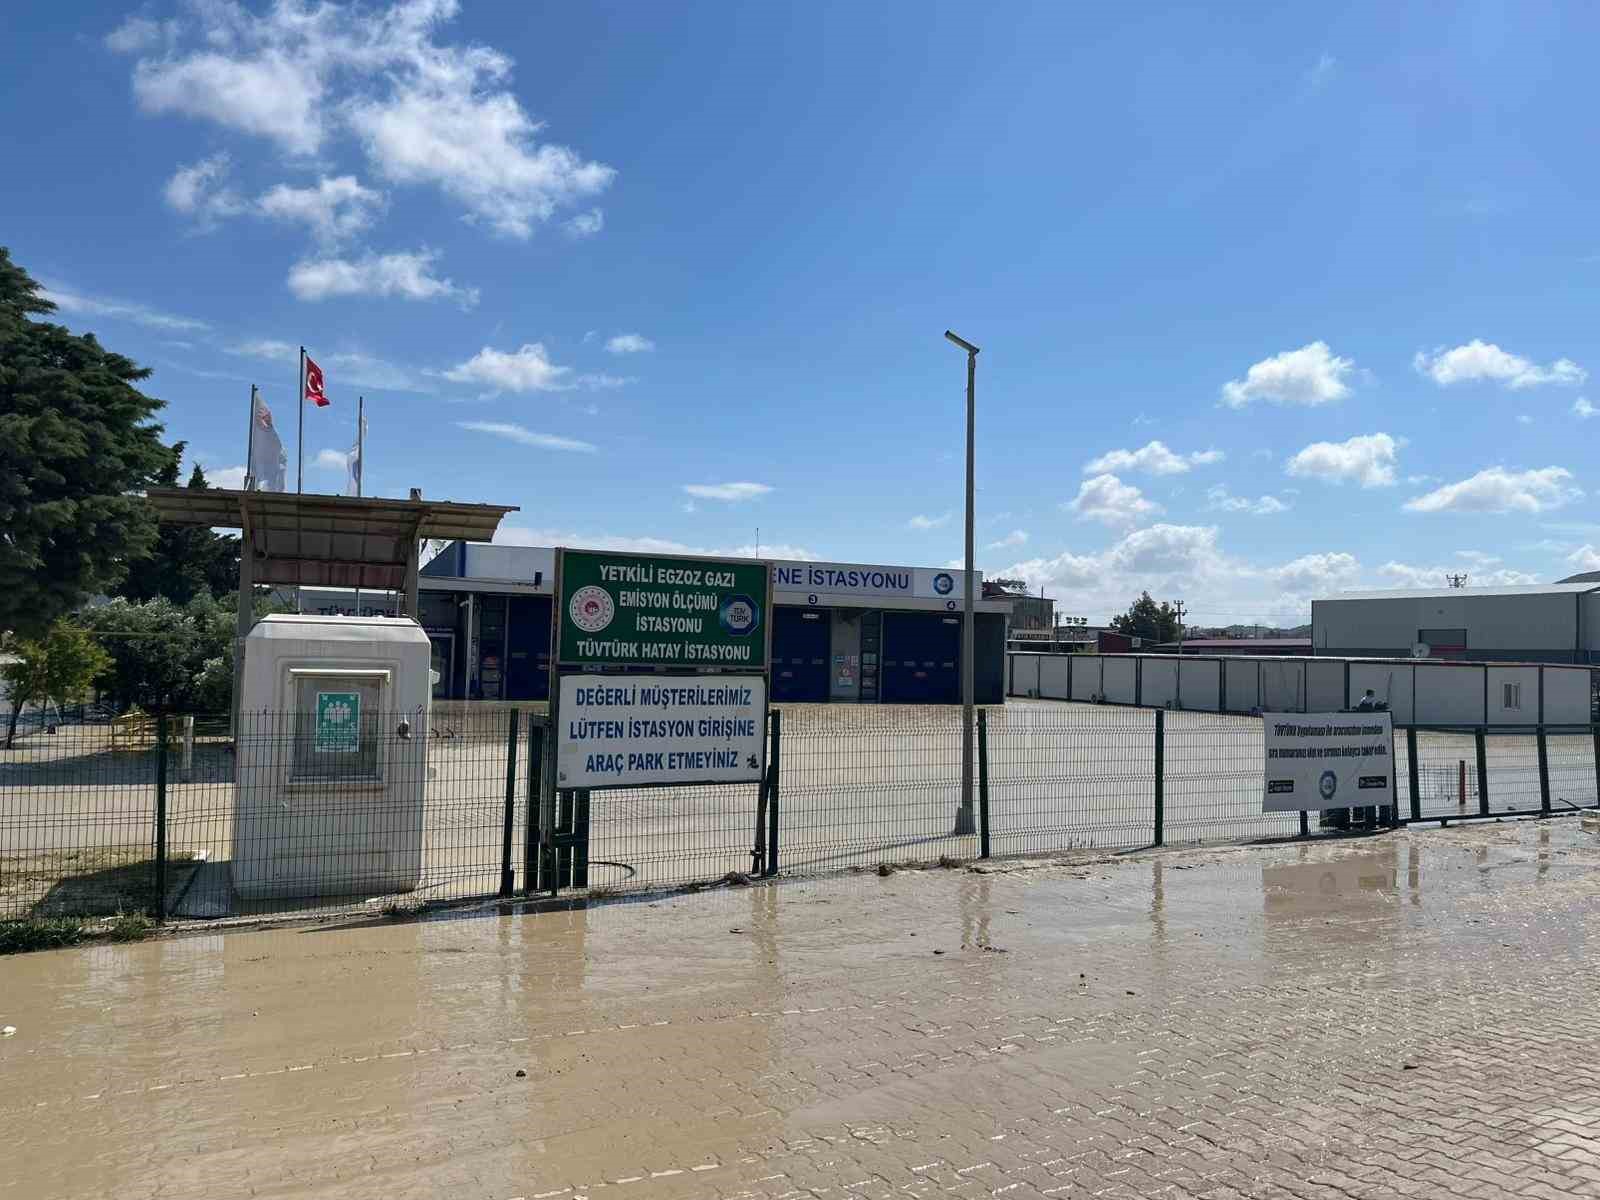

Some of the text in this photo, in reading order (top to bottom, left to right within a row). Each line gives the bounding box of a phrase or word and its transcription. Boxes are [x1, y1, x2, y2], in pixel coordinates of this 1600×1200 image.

[600, 564, 735, 587] YETKİLİ EGZOZ GAZI
[808, 565, 910, 589] İSTASYONU
[620, 588, 718, 613] EMİSYON ÖLÇÜMÜ
[636, 613, 703, 633] İSTASYONU
[577, 638, 751, 660] TÜVTÜRK HATAY İSTASYONU
[576, 684, 752, 710] DEĞERLİ MÜŞTERİLERİMİZ
[569, 715, 754, 740] LÜTFEN İSTASYON GİRİŞİNE
[585, 747, 738, 776] ARAÇ PARK ETMEYİNİZ
